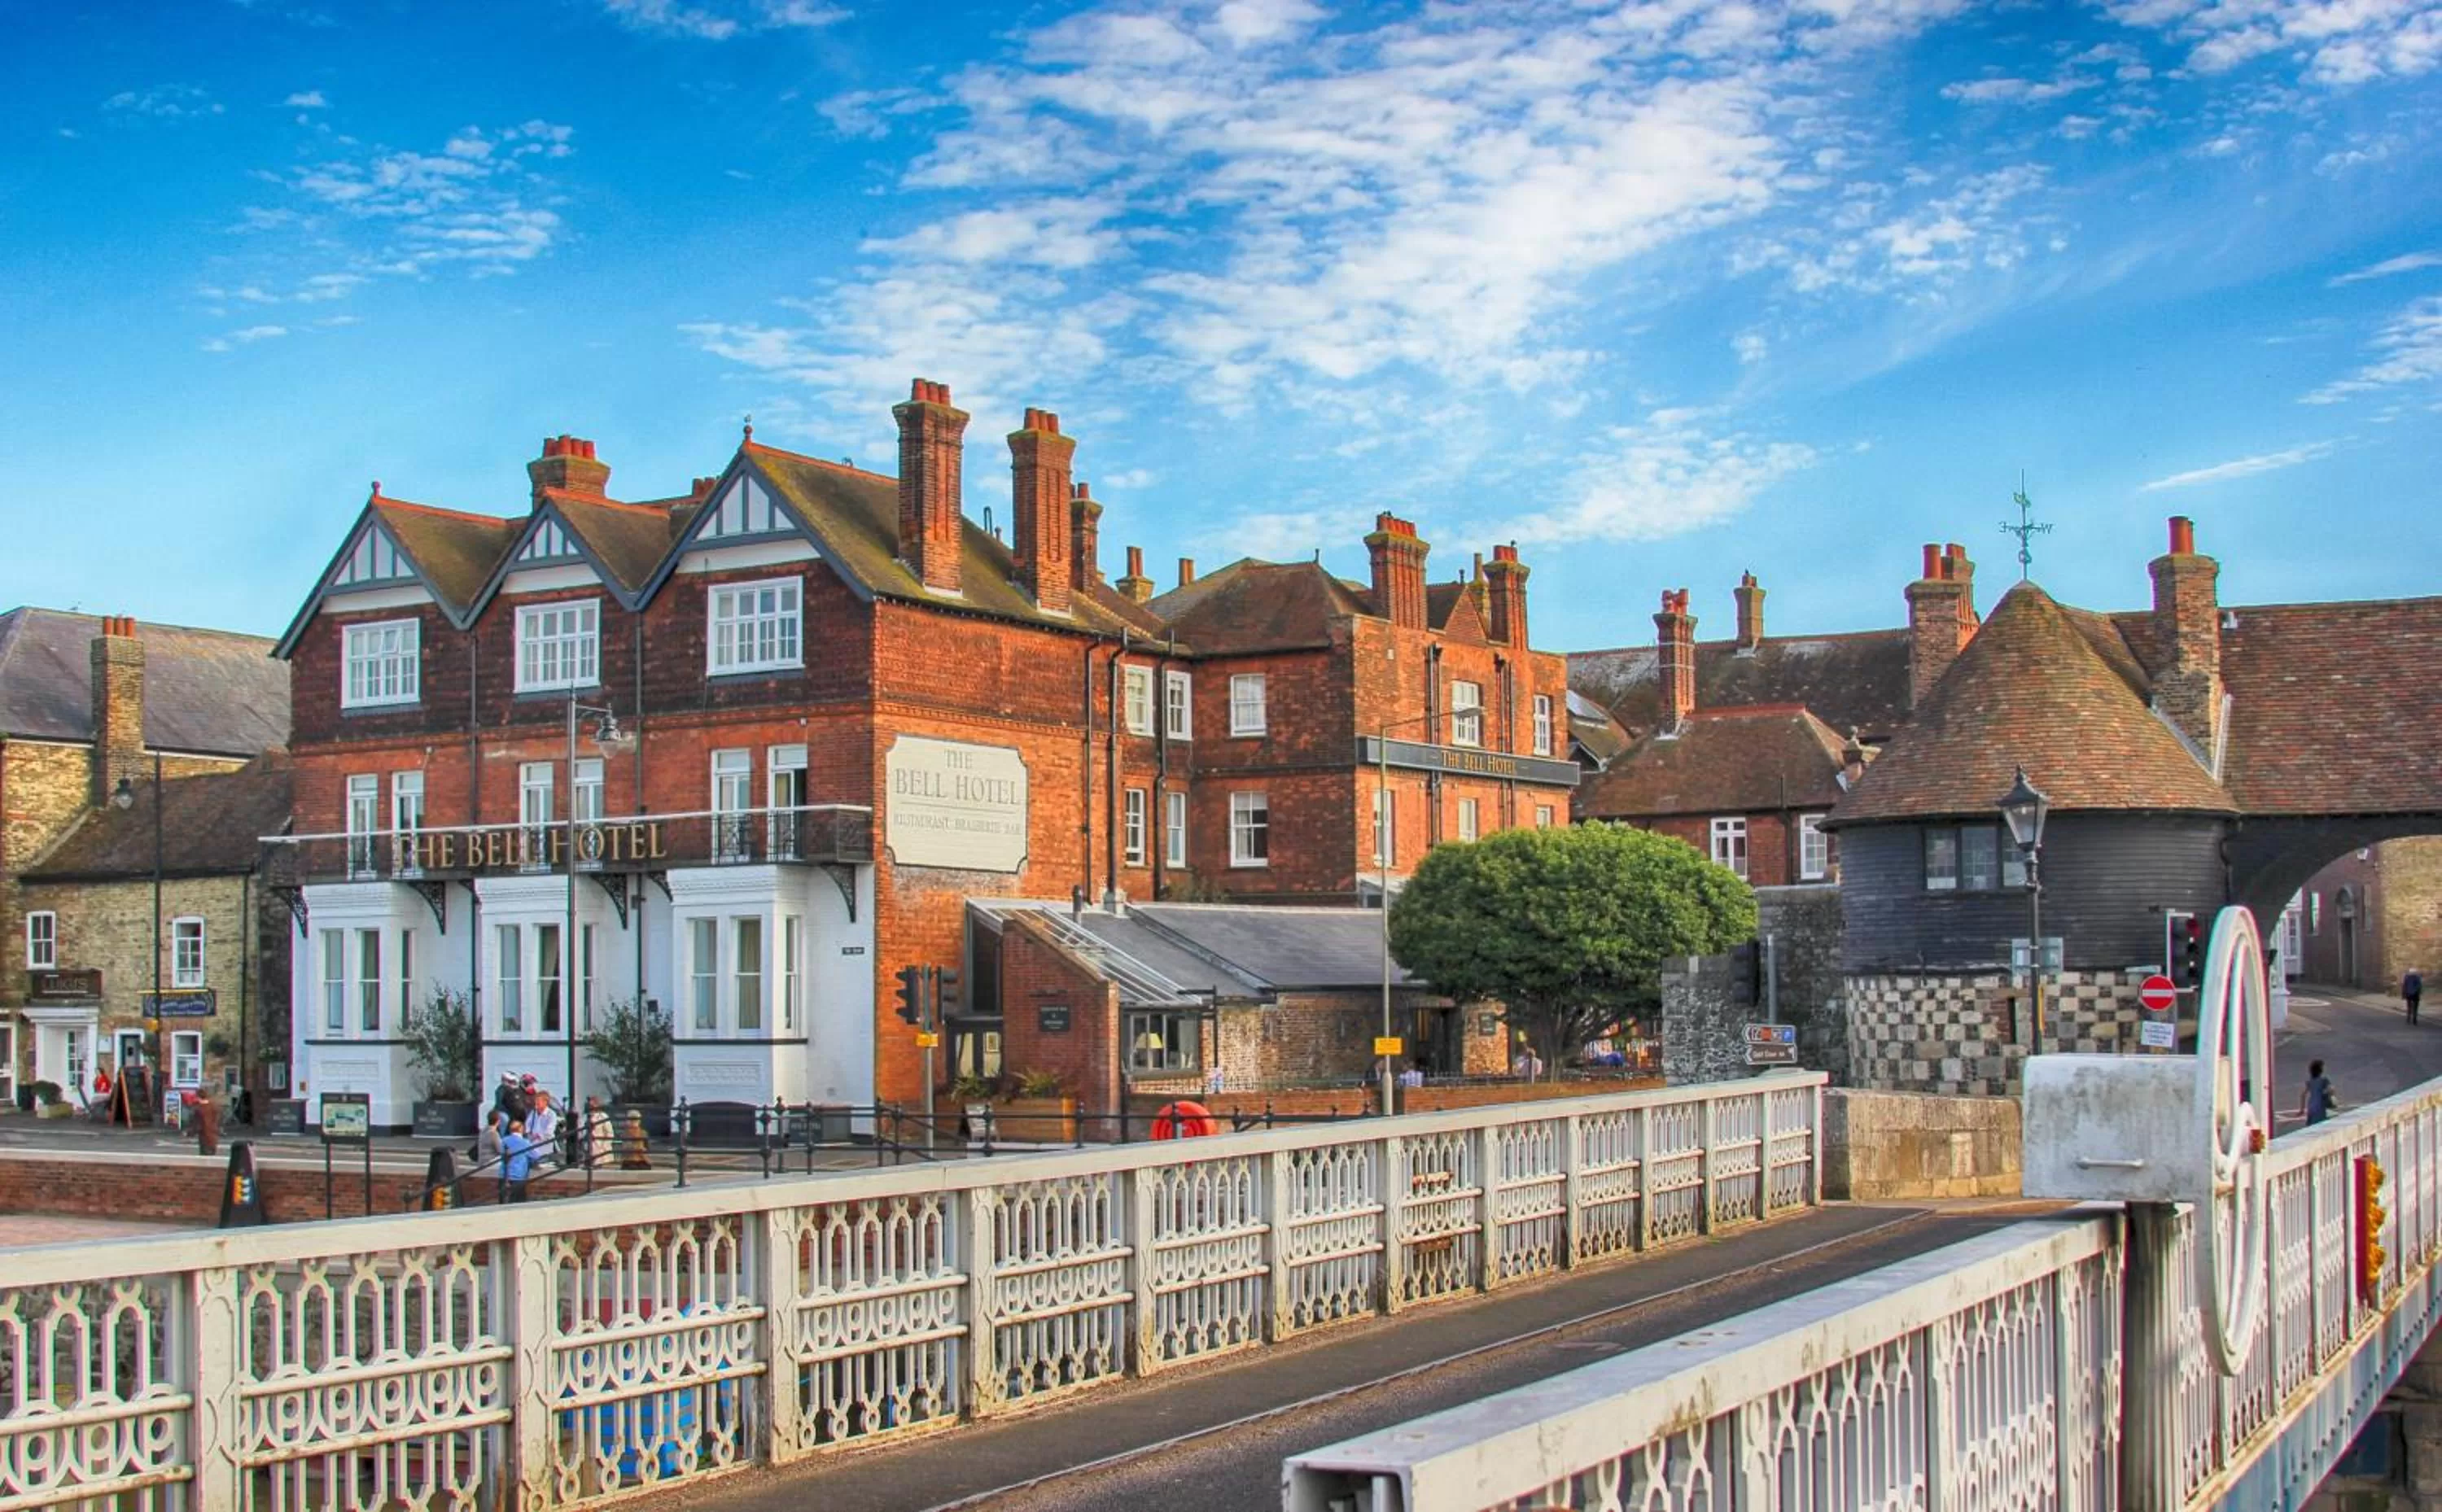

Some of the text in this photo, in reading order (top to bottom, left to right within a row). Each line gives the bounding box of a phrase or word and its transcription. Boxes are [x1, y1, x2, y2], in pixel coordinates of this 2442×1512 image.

[944, 749, 973, 769] THE
[1442, 750, 1514, 775] THE BELL HOTEL
[895, 768, 1019, 805] BELL HOTEL
[394, 823, 667, 870] THE BELL HOTEL
